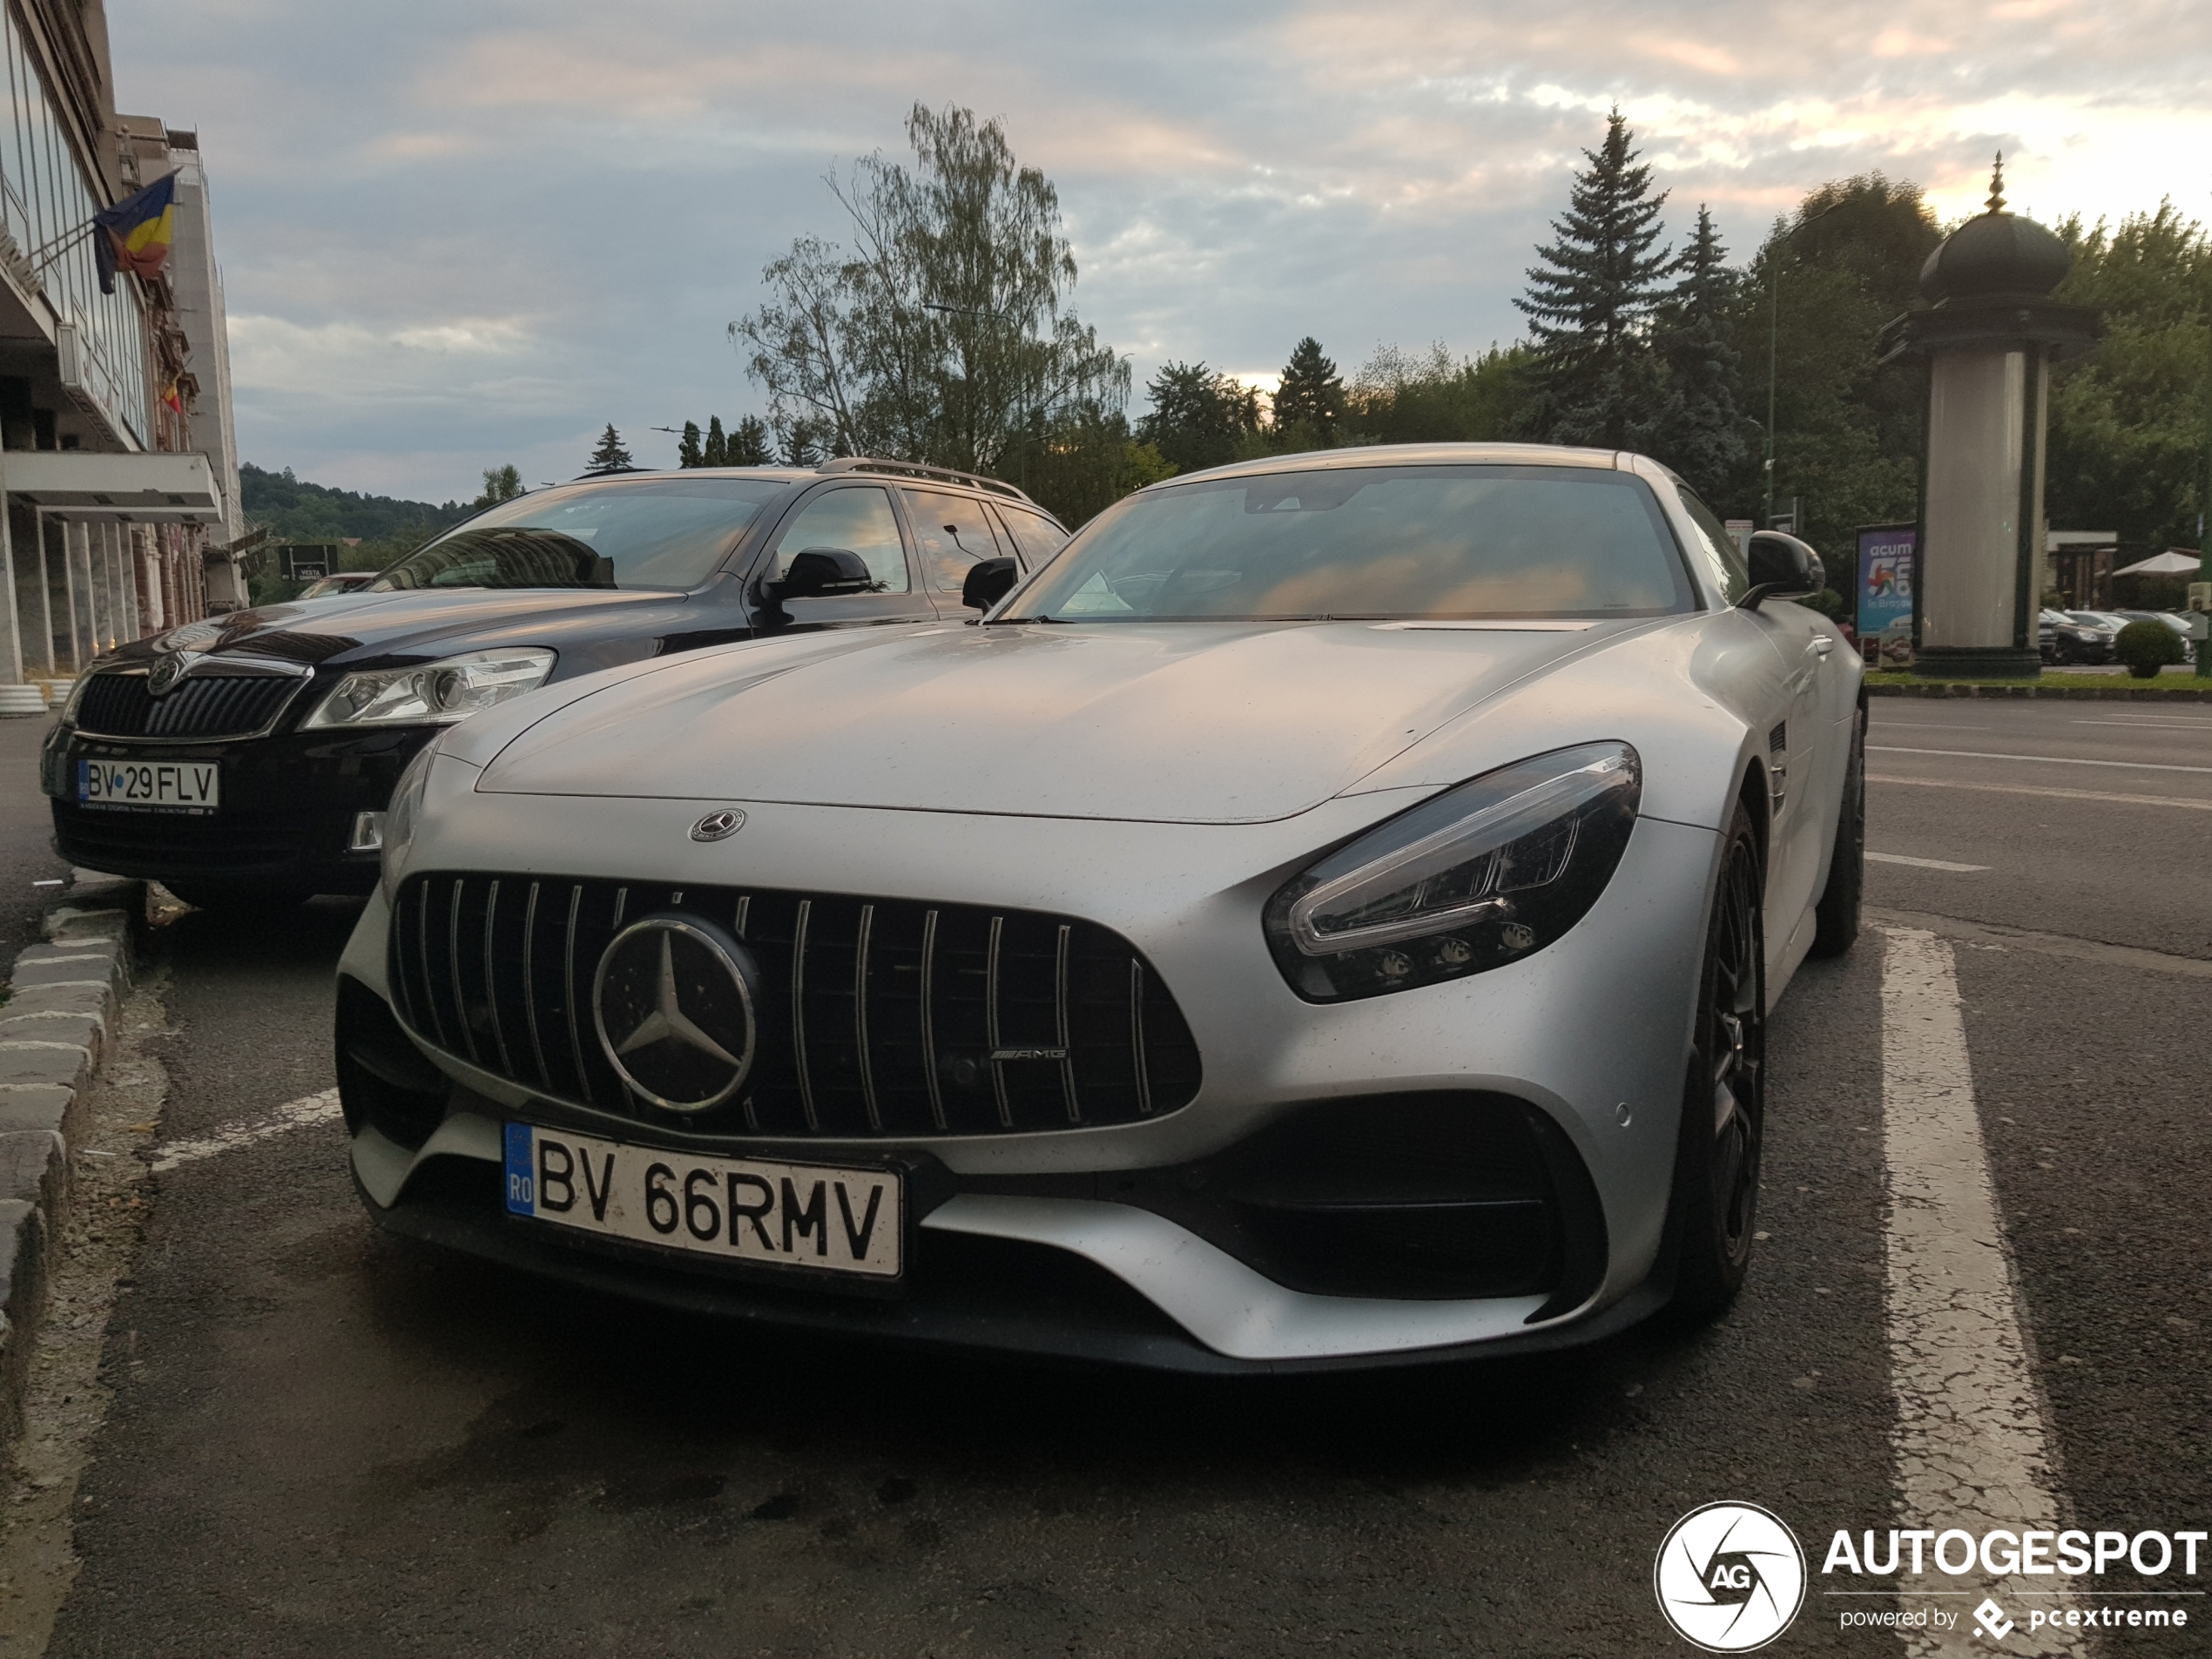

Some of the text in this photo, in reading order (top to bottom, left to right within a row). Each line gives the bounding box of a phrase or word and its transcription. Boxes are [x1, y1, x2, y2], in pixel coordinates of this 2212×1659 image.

[1870, 543, 1912, 556] acum
[88, 764, 116, 797] BV
[1014, 1049, 1066, 1059] AMG
[510, 1173, 532, 1203] RO
[539, 1138, 884, 1260] BV 66RMV
